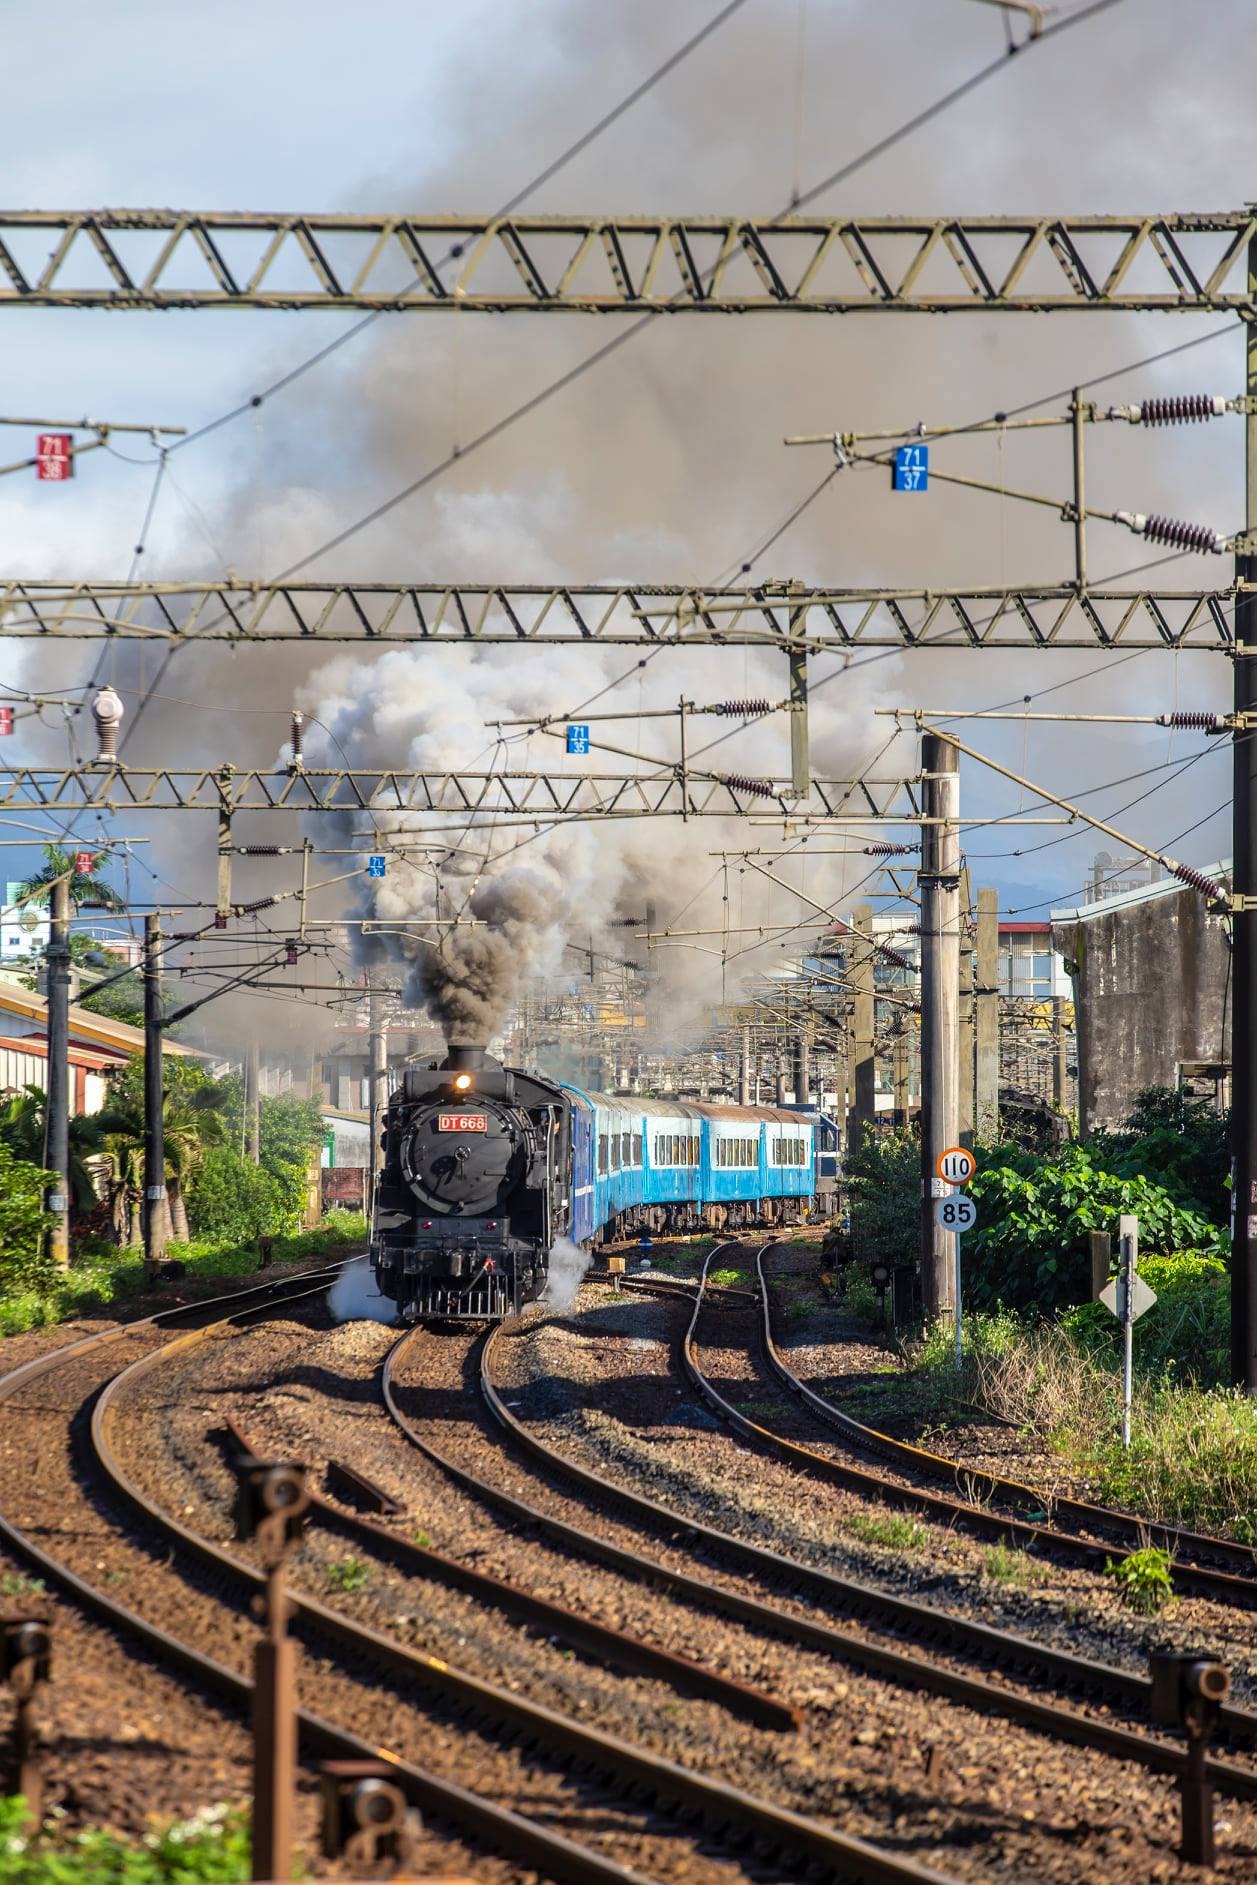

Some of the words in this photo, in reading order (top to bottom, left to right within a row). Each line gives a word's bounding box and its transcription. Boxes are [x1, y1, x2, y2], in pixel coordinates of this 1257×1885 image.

[43, 437, 62, 455] 71
[903, 447, 920, 465] 71
[903, 471, 920, 489] 37
[573, 726, 584, 738] 71
[574, 741, 585, 753] 35
[372, 857, 381, 866] 71
[944, 1158, 970, 1176] 110
[943, 1203, 971, 1224] 85
